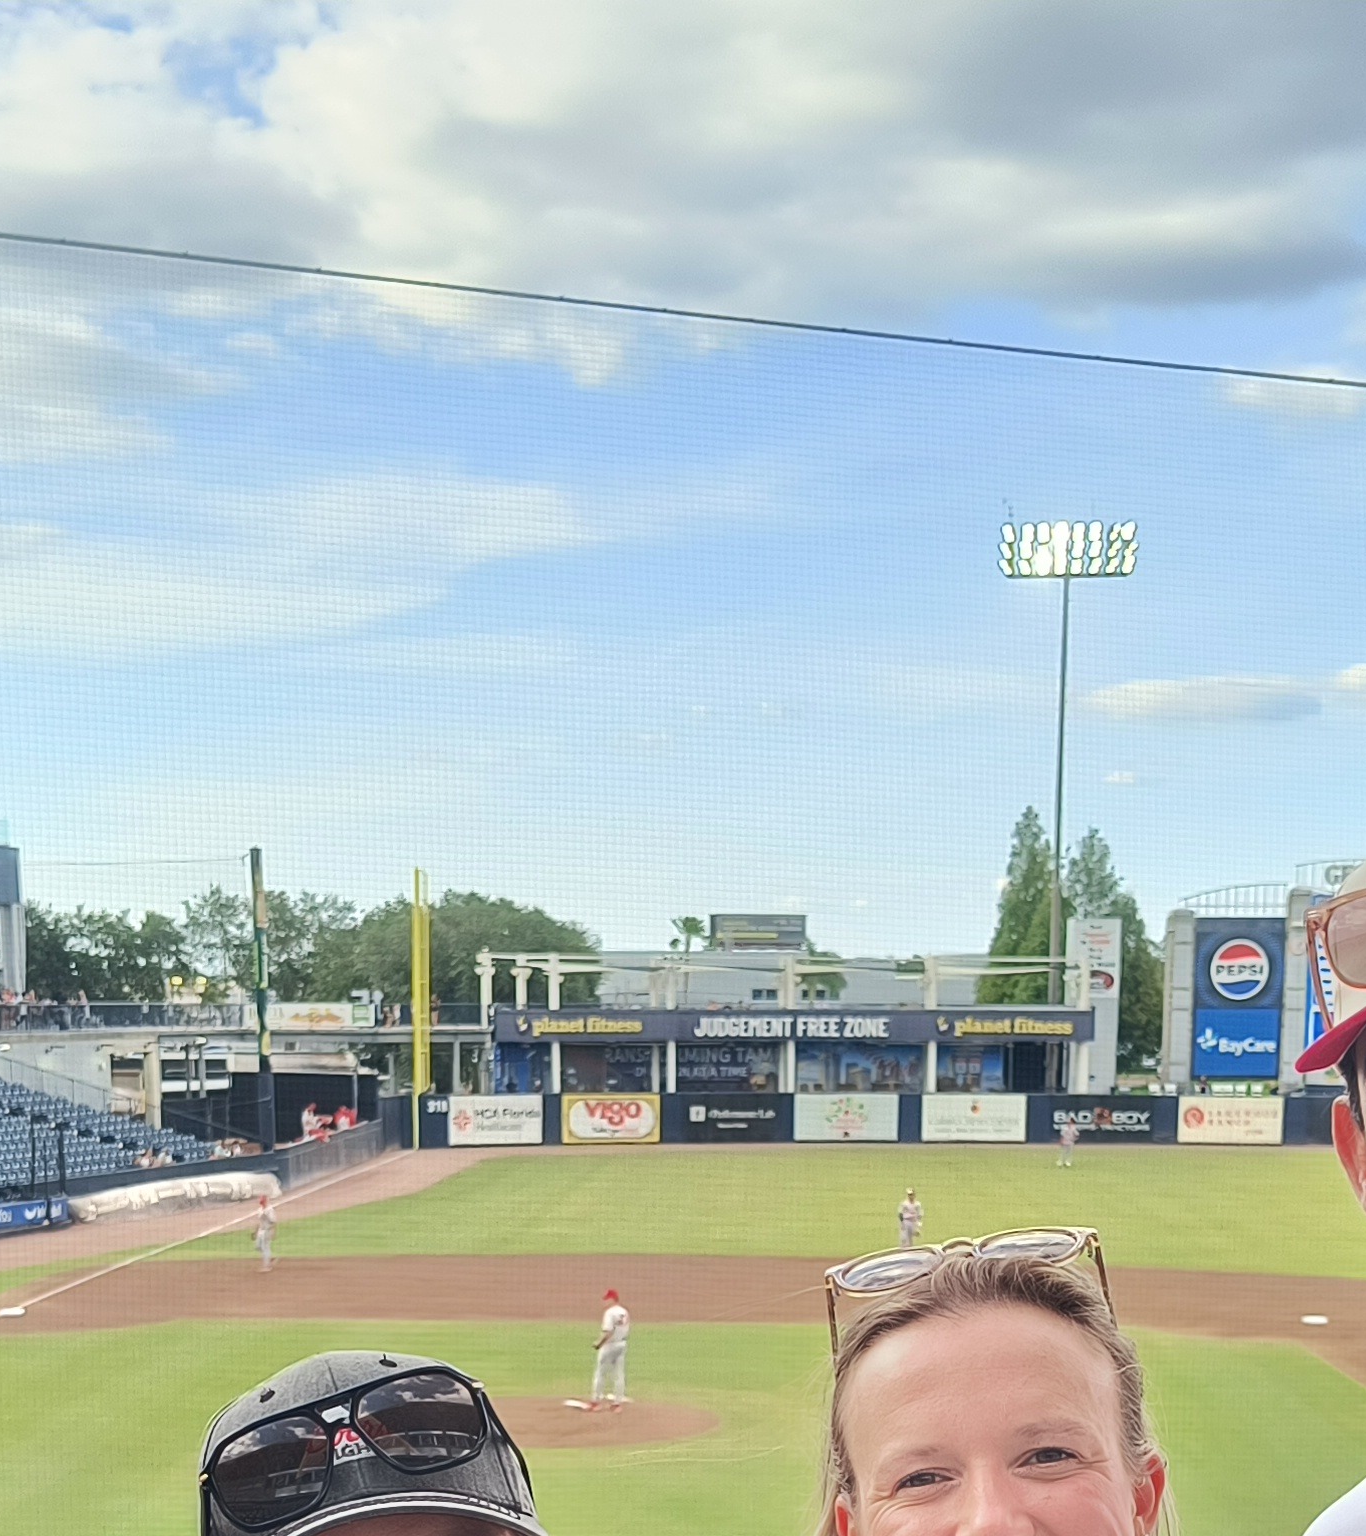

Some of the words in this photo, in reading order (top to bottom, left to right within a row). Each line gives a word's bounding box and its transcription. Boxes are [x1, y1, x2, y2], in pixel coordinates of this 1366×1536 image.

[1215, 964, 1264, 977] PEPSI
[531, 1016, 585, 1037] planet
[586, 1016, 643, 1034] fitness
[693, 1015, 795, 1038] JUDGEMENT
[796, 1016, 841, 1038] FREE
[843, 1016, 890, 1038] ZONE
[953, 1016, 1012, 1038] planet
[1013, 1016, 1074, 1036] fitness
[1218, 1036, 1277, 1057] BayCare
[1053, 1109, 1093, 1125] BAD
[1111, 1109, 1150, 1125] BOY
